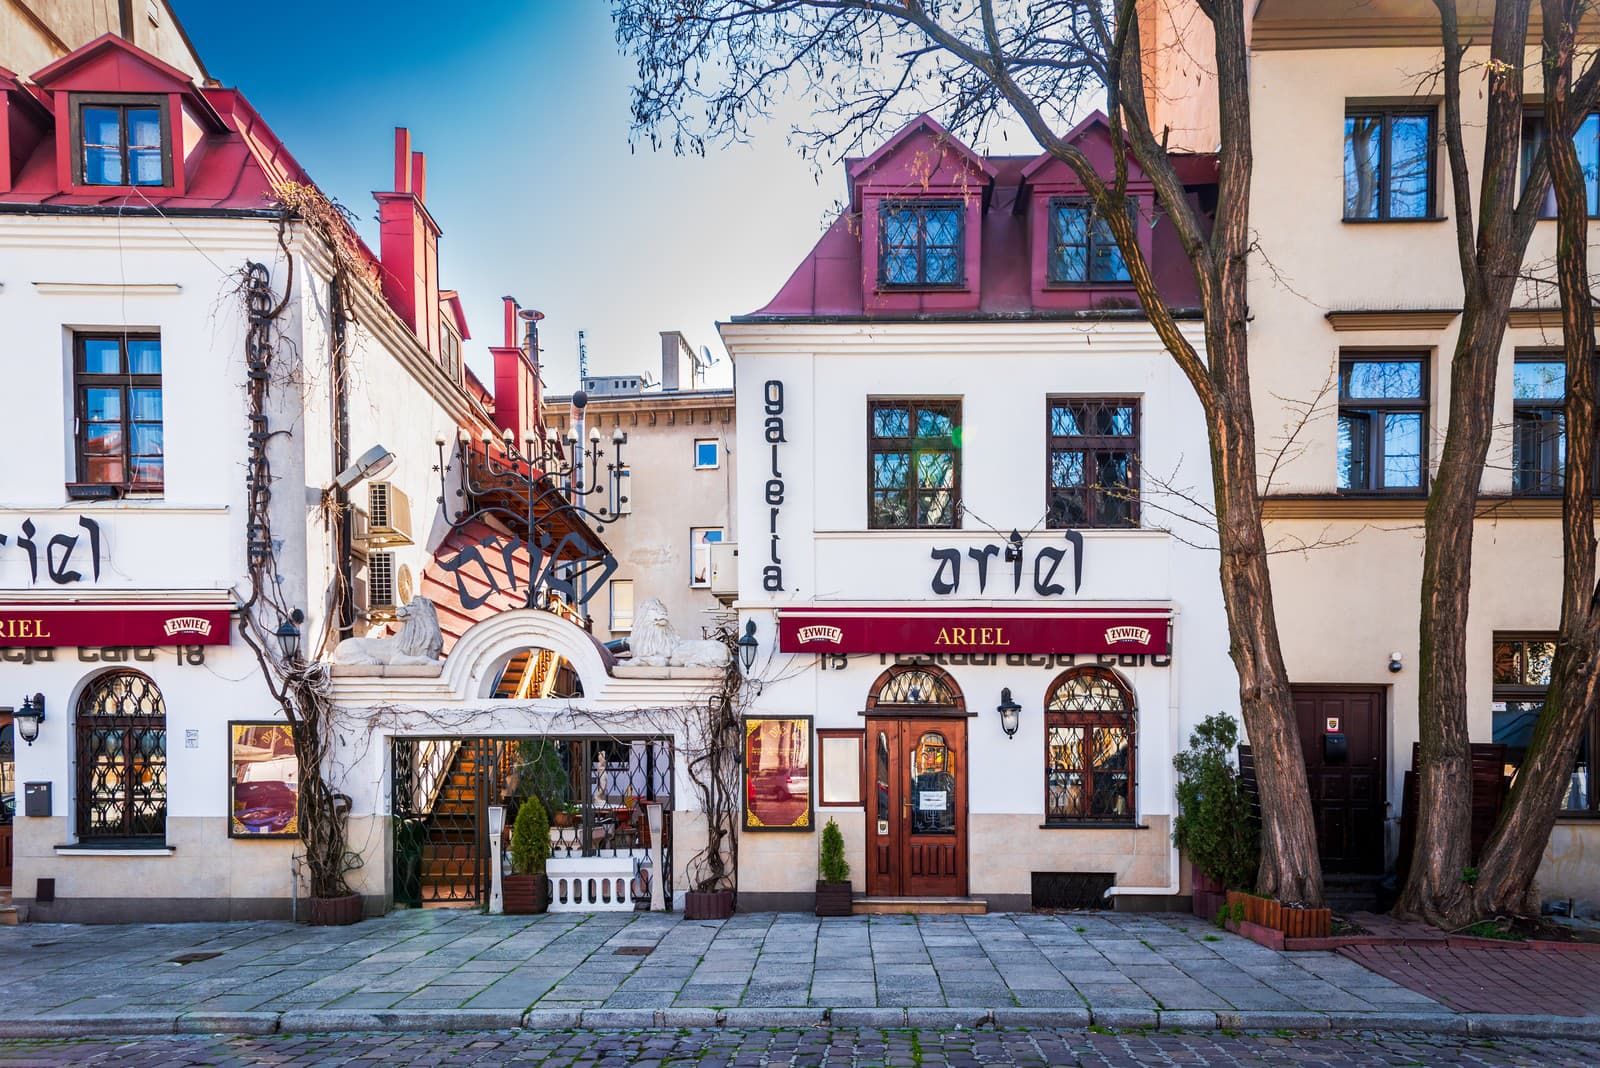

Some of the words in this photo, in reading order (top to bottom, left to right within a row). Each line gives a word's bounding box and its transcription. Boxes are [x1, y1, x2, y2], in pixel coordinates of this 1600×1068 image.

[763, 380, 788, 591] galeria
[0, 515, 100, 584] iel
[931, 528, 1083, 595] ariel
[170, 618, 206, 630] ŻYWIEC
[802, 626, 838, 638] ŻYWIEC
[1110, 627, 1146, 639] ŻYWIEC
[934, 626, 1010, 646] ARIEL
